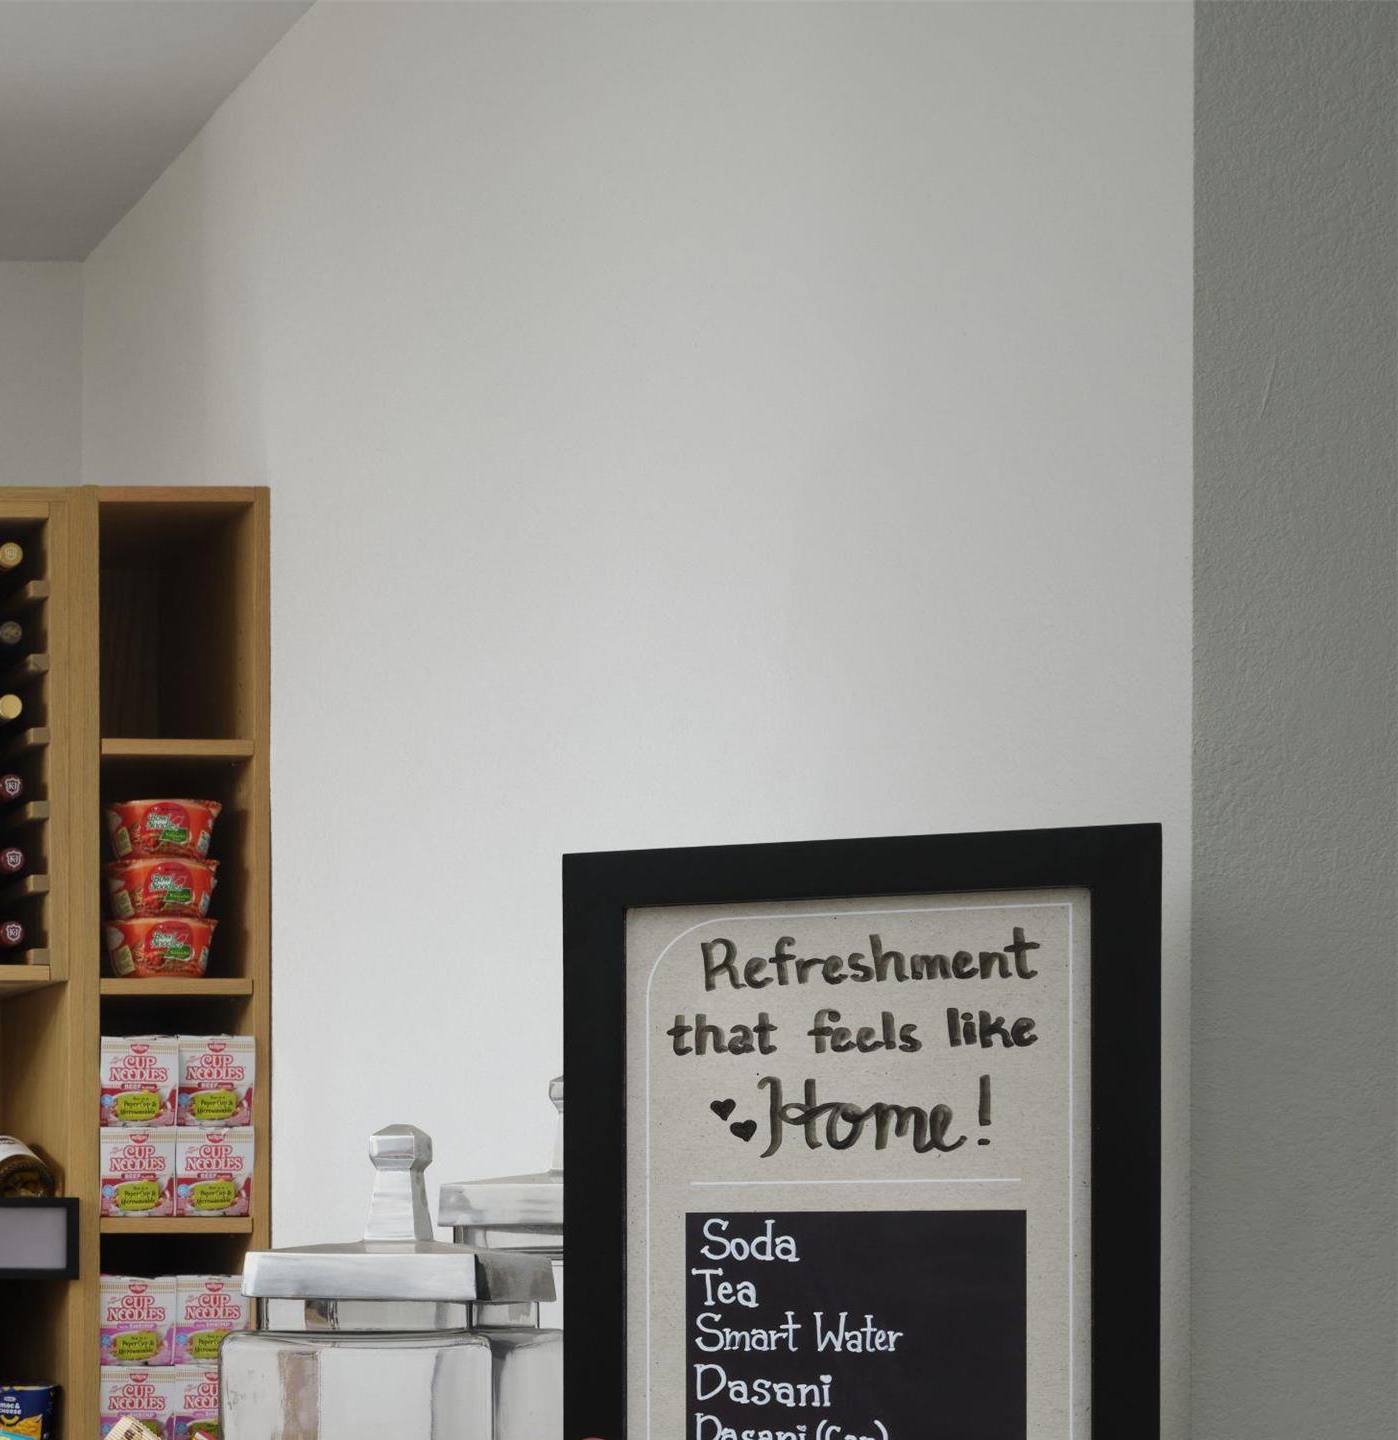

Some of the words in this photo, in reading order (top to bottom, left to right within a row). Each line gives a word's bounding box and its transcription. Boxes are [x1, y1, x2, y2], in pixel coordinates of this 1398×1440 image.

[698, 925, 1044, 994] Refreshment
[664, 1010, 781, 1058] that
[805, 1006, 925, 1056] feels
[944, 1005, 1041, 1051] like
[122, 1055, 157, 1069] CUP
[199, 1054, 234, 1068] CUP
[109, 1066, 169, 1082] NOODLES
[185, 1066, 245, 1081] NOODLES
[122, 1145, 156, 1159] CUP
[198, 1144, 233, 1158] CUP
[109, 1156, 166, 1172] NOODLES
[185, 1156, 244, 1172] NOODLES
[698, 1217, 803, 1265] Soda
[689, 1265, 761, 1311] Tea
[692, 1309, 802, 1355] Smart
[812, 1309, 906, 1355] Water
[692, 1361, 834, 1410] Dasani
